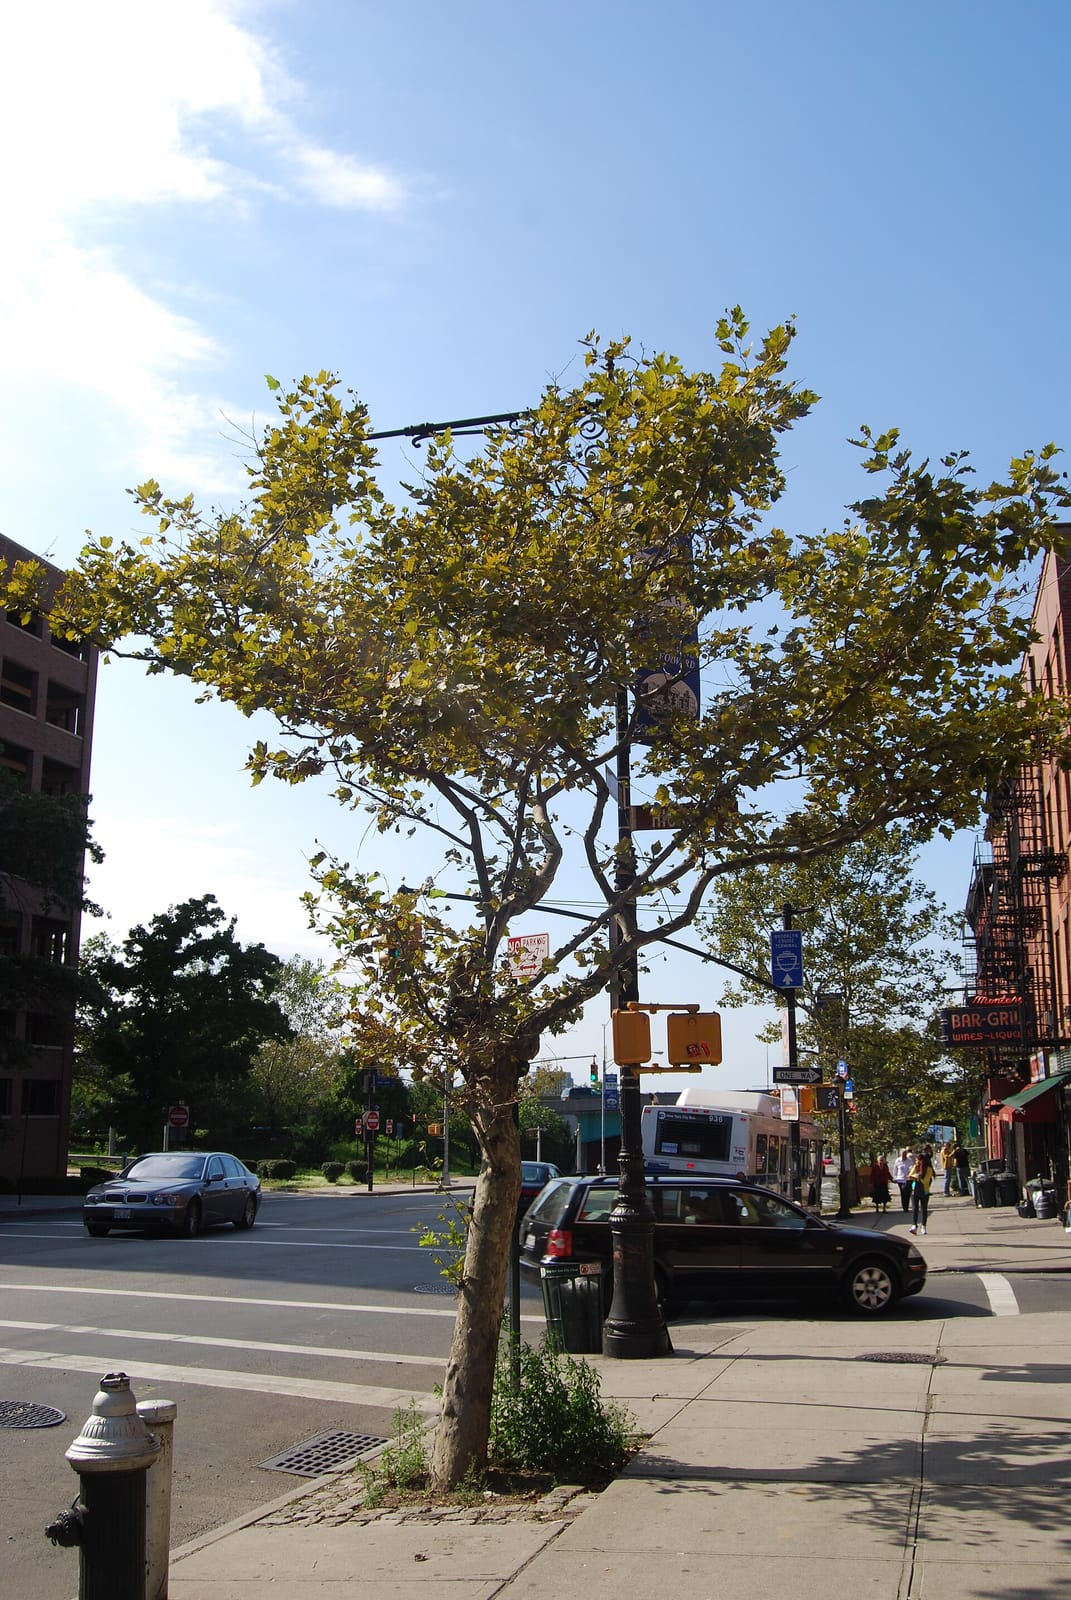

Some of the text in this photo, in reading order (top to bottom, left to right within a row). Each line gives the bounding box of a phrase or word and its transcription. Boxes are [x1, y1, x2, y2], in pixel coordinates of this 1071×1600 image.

[659, 652, 695, 669] FORWRD
[522, 936, 546, 947] PARKING
[779, 1071, 794, 1079] ONE
